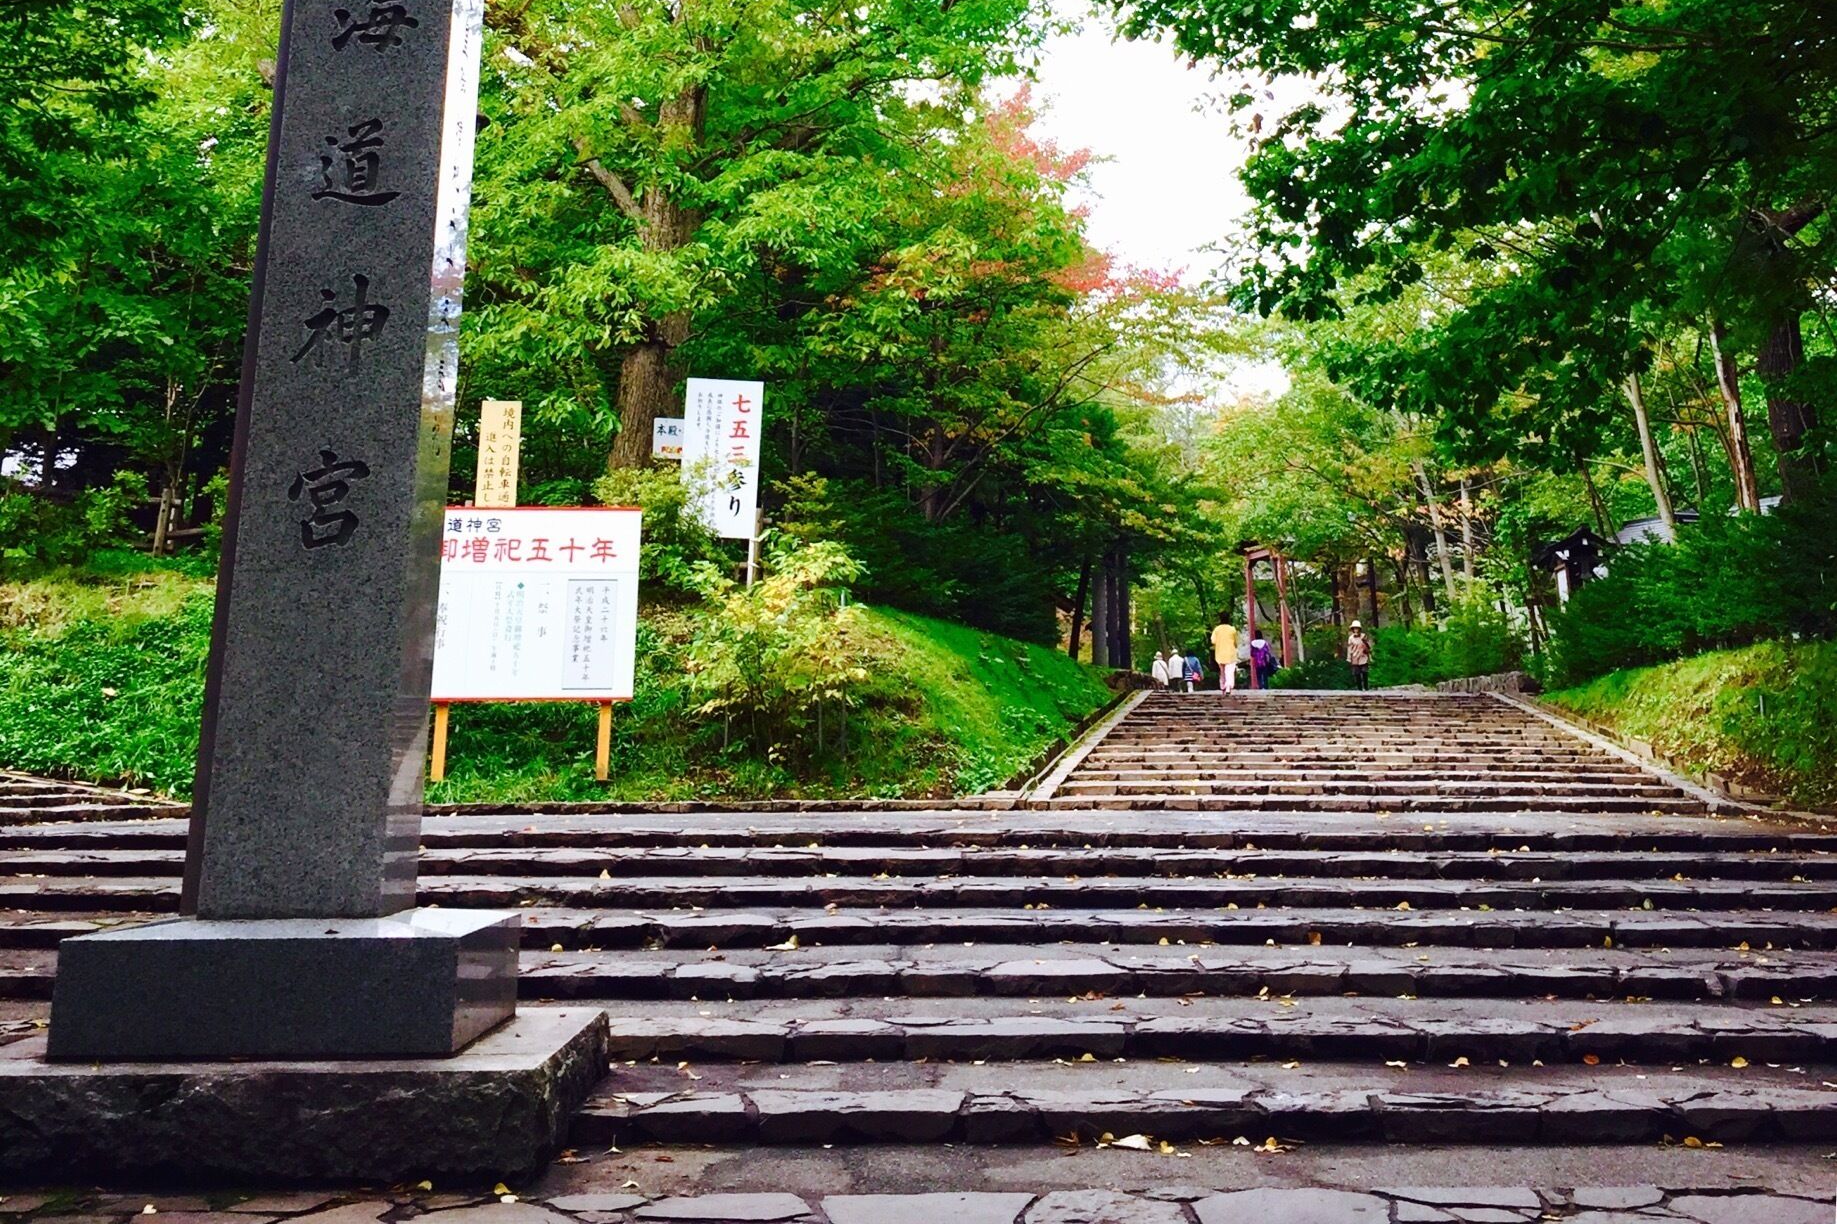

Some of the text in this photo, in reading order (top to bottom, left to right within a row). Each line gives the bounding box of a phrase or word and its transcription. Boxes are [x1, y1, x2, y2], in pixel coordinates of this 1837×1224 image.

[481, 431, 497, 507] 進入は禁止し
[447, 518, 502, 533] 道神宮
